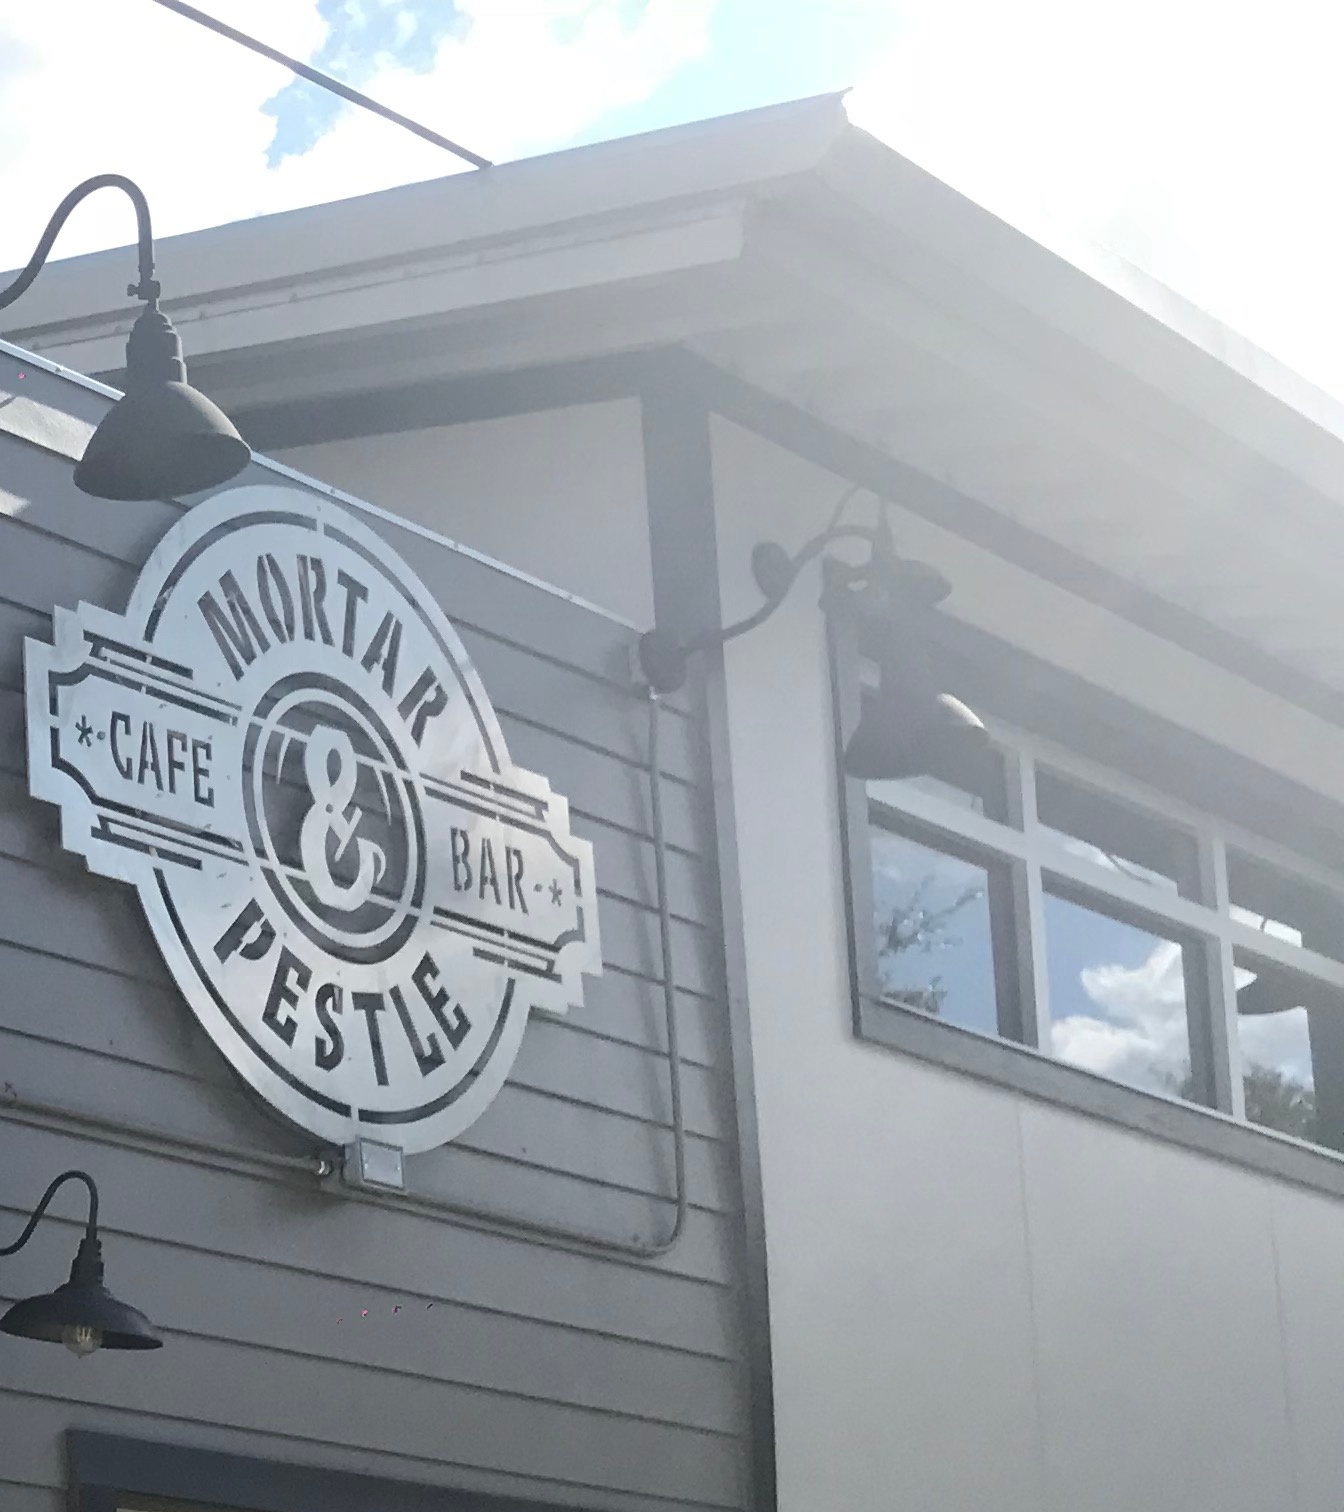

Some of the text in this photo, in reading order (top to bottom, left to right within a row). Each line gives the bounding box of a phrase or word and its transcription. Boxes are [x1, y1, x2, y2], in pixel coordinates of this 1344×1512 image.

[197, 554, 448, 744] MORTAR
[111, 712, 214, 808] CAFE
[450, 826, 530, 915] BAR
[213, 898, 472, 1086] PESTLE
